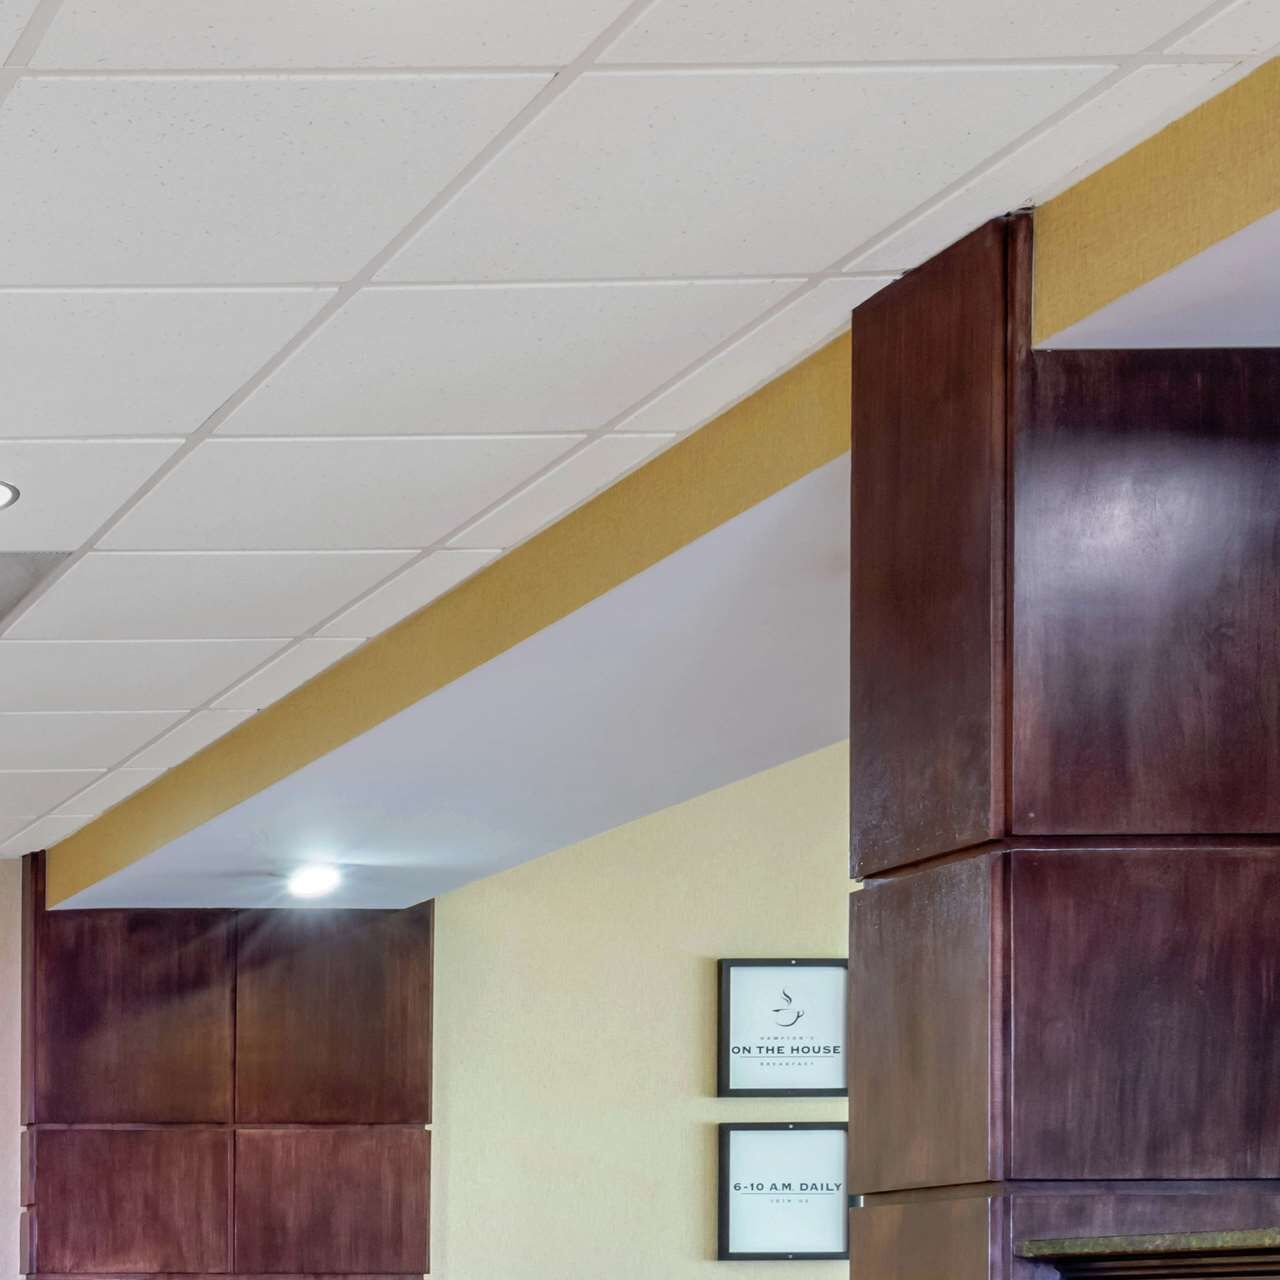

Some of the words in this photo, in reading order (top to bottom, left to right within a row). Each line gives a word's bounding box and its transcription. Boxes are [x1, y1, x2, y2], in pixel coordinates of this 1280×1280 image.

[731, 1045, 752, 1055] ON
[756, 1045, 785, 1055] THE
[790, 1045, 841, 1055] HOUSE
[733, 1182, 765, 1192] 6-10
[800, 1182, 842, 1192] DAILY
